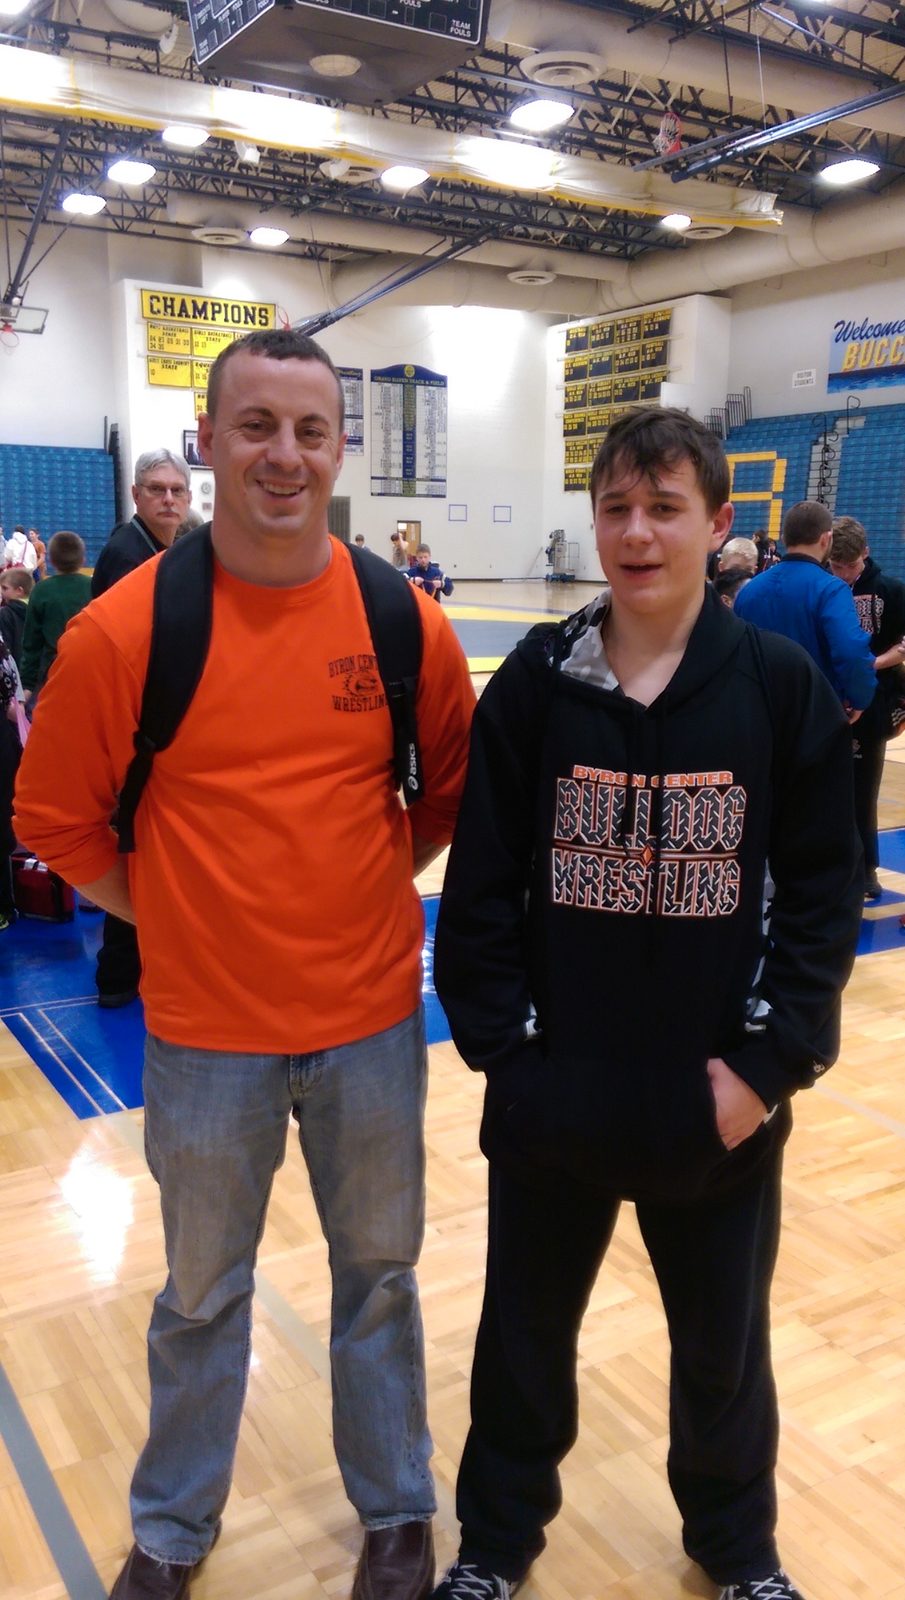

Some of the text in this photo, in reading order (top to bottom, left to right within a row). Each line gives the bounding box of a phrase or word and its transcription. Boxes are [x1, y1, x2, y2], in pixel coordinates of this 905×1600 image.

[450, 26, 471, 38] FOULS
[452, 19, 471, 30] TEAM
[149, 294, 269, 327] CHAMPIONS
[834, 317, 905, 343] Welcome
[332, 693, 387, 713] WRESTLIN
[409, 743, 417, 775] asics
[573, 764, 646, 788] BYRON
[554, 777, 747, 851] BULLDOG
[552, 847, 741, 917] WRESTLING
